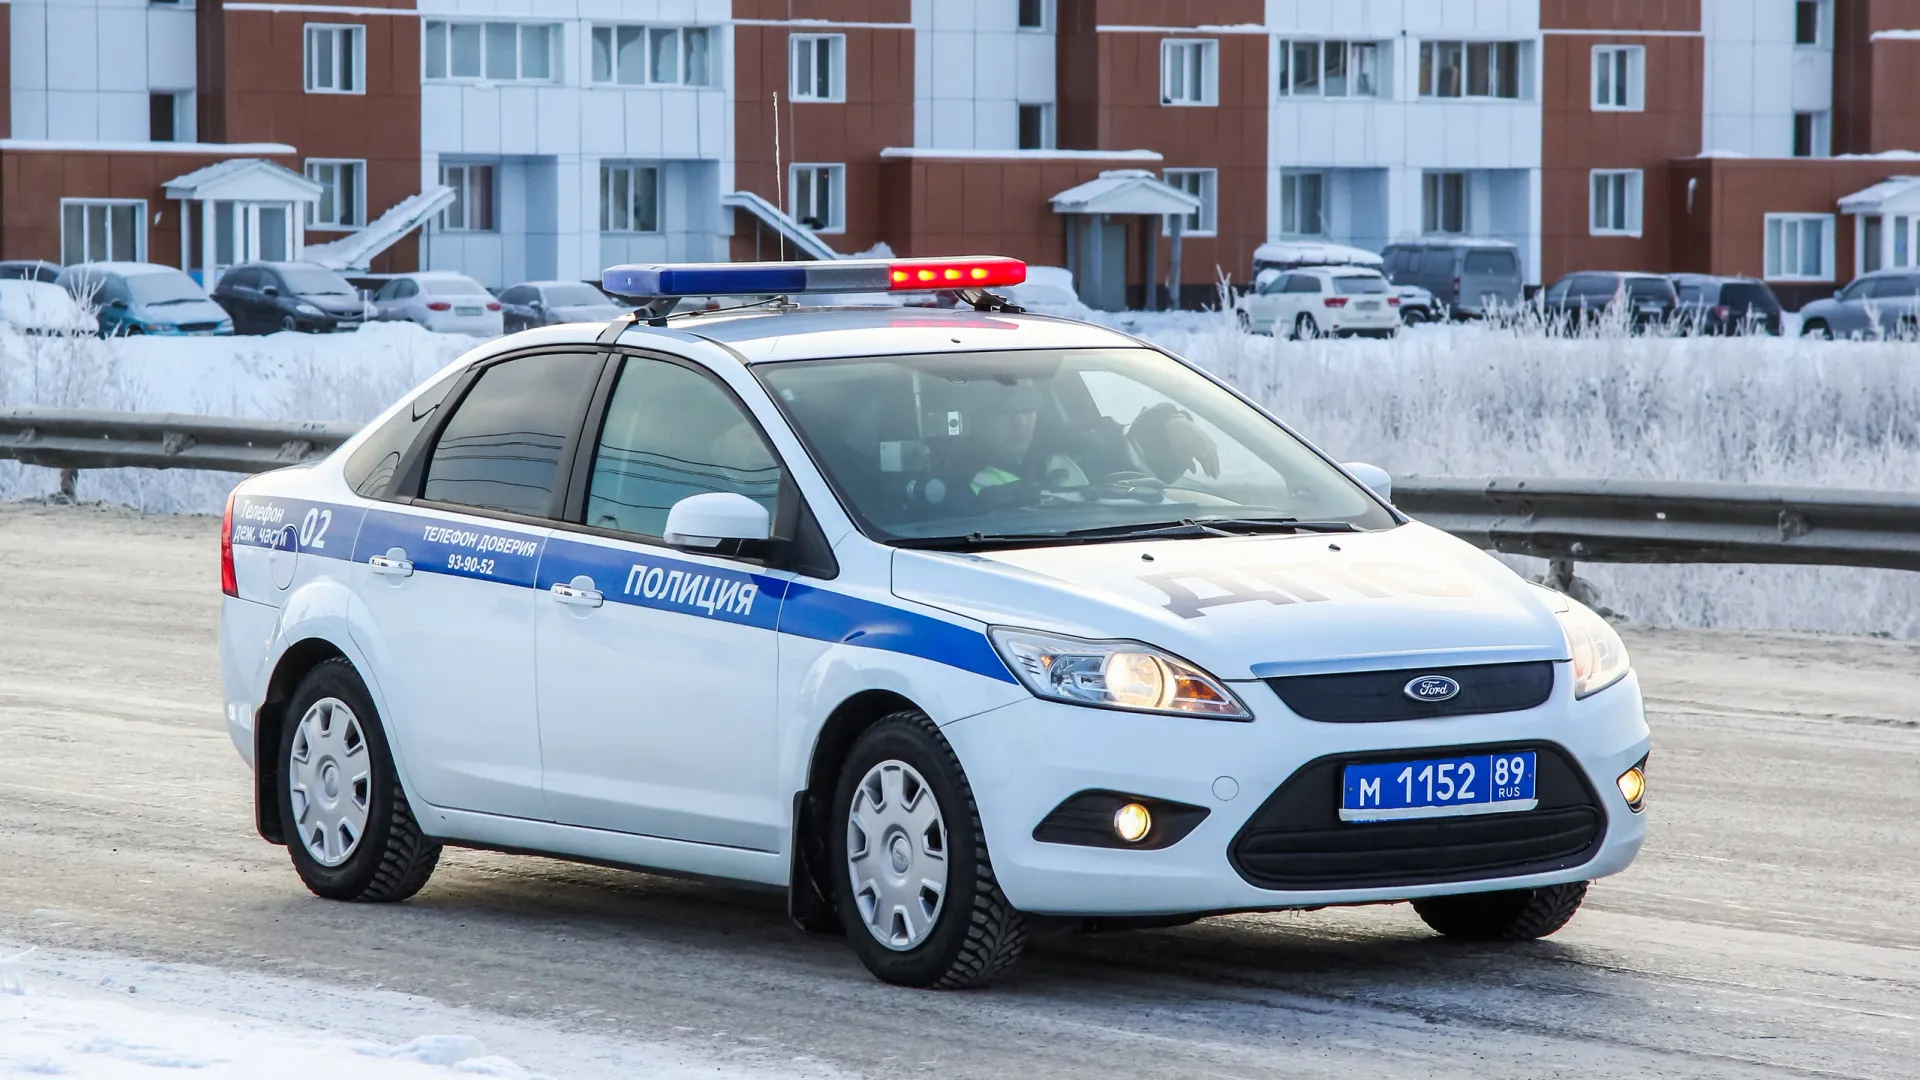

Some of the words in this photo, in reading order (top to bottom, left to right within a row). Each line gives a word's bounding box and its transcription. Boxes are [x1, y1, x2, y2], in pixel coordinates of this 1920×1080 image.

[240, 500, 285, 524] Телефон
[233, 523, 256, 543] деж.
[258, 527, 288, 547] части
[299, 507, 333, 549] 02
[422, 525, 479, 549] ТЕЛЕФОН
[476, 534, 538, 558] ДОВЕРИЯ
[447, 553, 495, 575] 93-90-52
[623, 564, 759, 616] ПОЛИЦИЯ
[1419, 680, 1448, 695] Ford
[1396, 762, 1476, 804] 1152
[1494, 756, 1525, 786] 89
[1498, 786, 1521, 798] RUS
